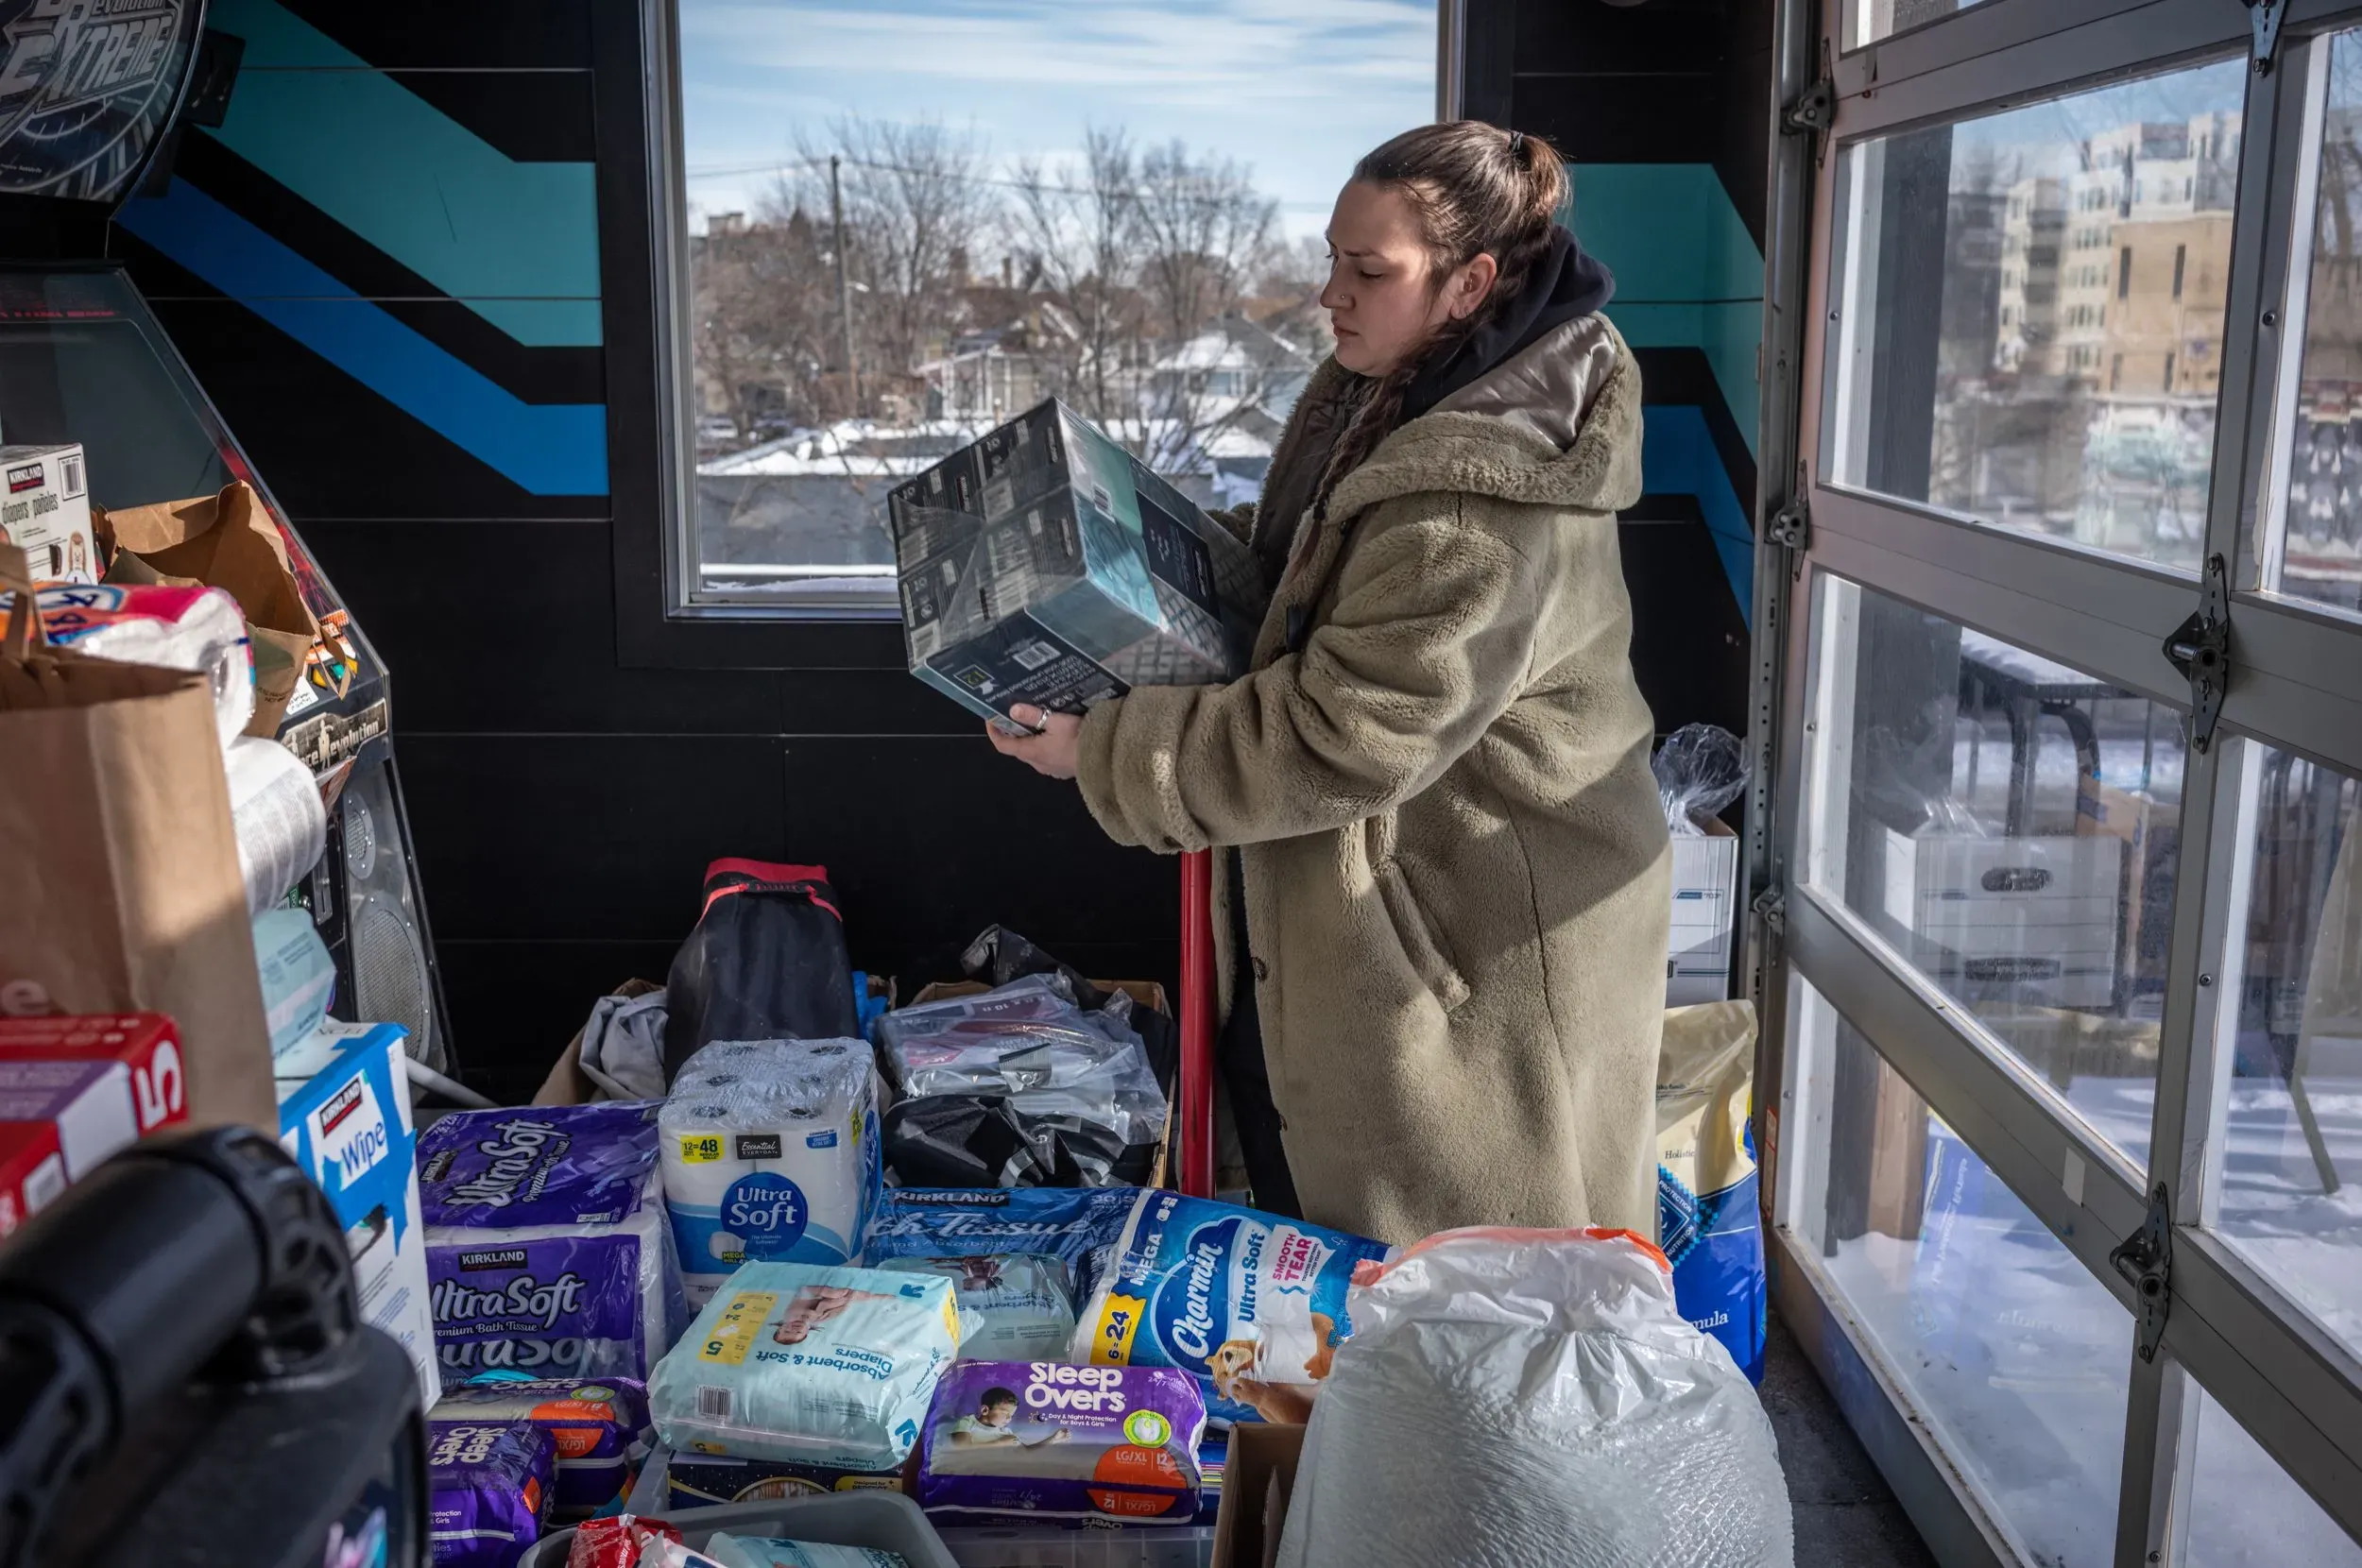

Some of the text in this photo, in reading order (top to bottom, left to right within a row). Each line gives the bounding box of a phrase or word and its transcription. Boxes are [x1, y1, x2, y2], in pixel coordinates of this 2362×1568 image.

[9, 466, 43, 485] KIRKLAND
[2, 492, 59, 525] diapers pañales
[134, 1040, 183, 1130] 5
[322, 1080, 362, 1125] KIRKLAND
[340, 1120, 386, 1178] Wipe
[741, 1141, 776, 1151] Essential
[1664, 1150, 1696, 1161] Holistic
[737, 1186, 792, 1203] Ultra
[895, 1191, 1006, 1203] KIRKLAND
[1658, 1180, 1693, 1214] PROTECTION
[728, 1201, 798, 1232] Soft
[1272, 1232, 1297, 1281] SMOOTH
[1666, 1224, 1695, 1258] NUTRITION
[462, 1251, 525, 1266] KIRKLAND
[1129, 1233, 1163, 1287] MEGA
[1283, 1236, 1313, 1282] TEAR
[1237, 1233, 1266, 1323] Ultra Soft
[1172, 1241, 1224, 1359] Charmin
[434, 1321, 539, 1338] remium Bath Tissue
[725, 1313, 742, 1321] 24
[705, 1340, 725, 1356] 5
[835, 1348, 893, 1374] Diapers
[756, 1350, 890, 1381] Absorbent & Soft
[1028, 1361, 1123, 1393] Sleep
[1148, 1375, 1167, 1387] 24/7
[1024, 1383, 1126, 1412] Overs
[430, 1426, 480, 1466] Overs
[461, 1426, 507, 1463] Sleep
[694, 1442, 708, 1453] 5
[1115, 1450, 1169, 1465] LG/XL 12
[1104, 1497, 1157, 1512] LG/XL 12
